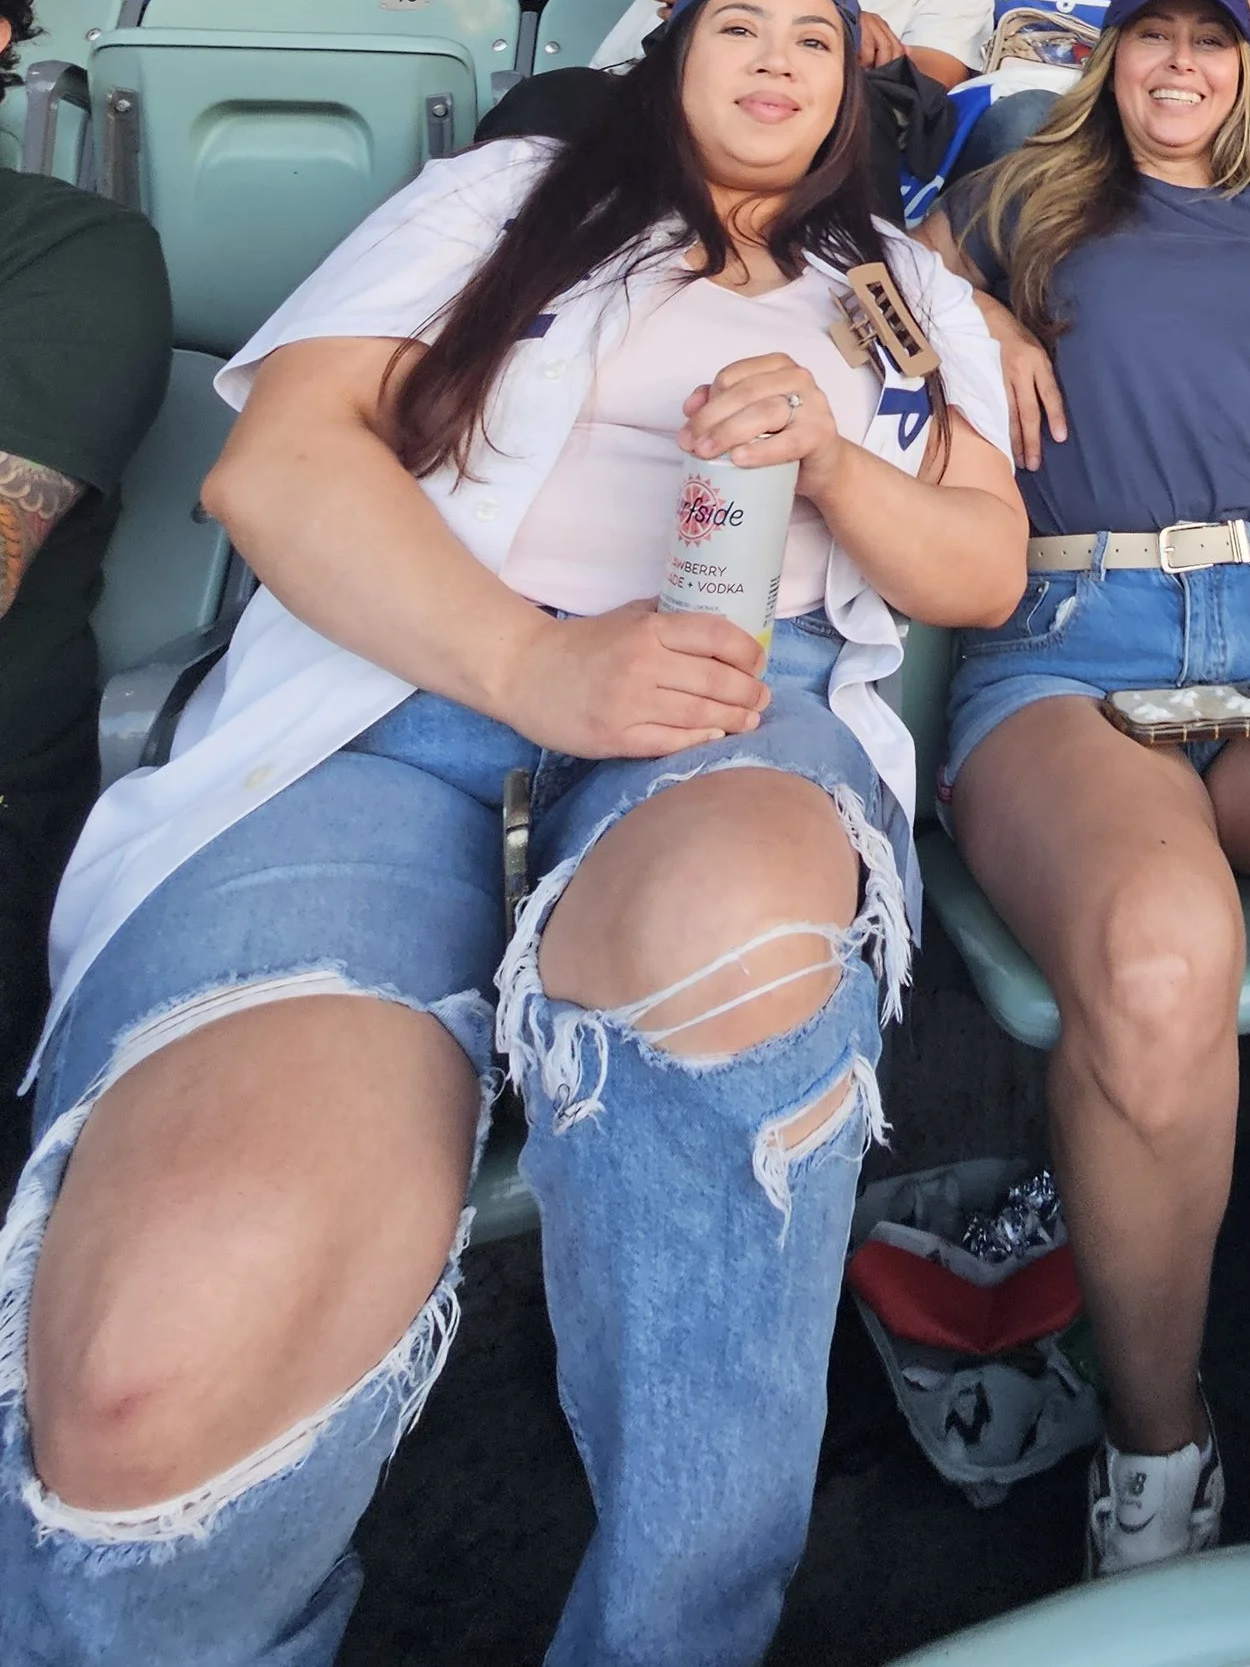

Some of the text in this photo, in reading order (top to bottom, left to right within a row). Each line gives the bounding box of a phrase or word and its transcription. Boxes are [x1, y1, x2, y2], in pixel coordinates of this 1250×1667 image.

[682, 496, 744, 528] rfside
[669, 555, 727, 577] AWBERRY
[698, 581, 744, 594] VODKA
